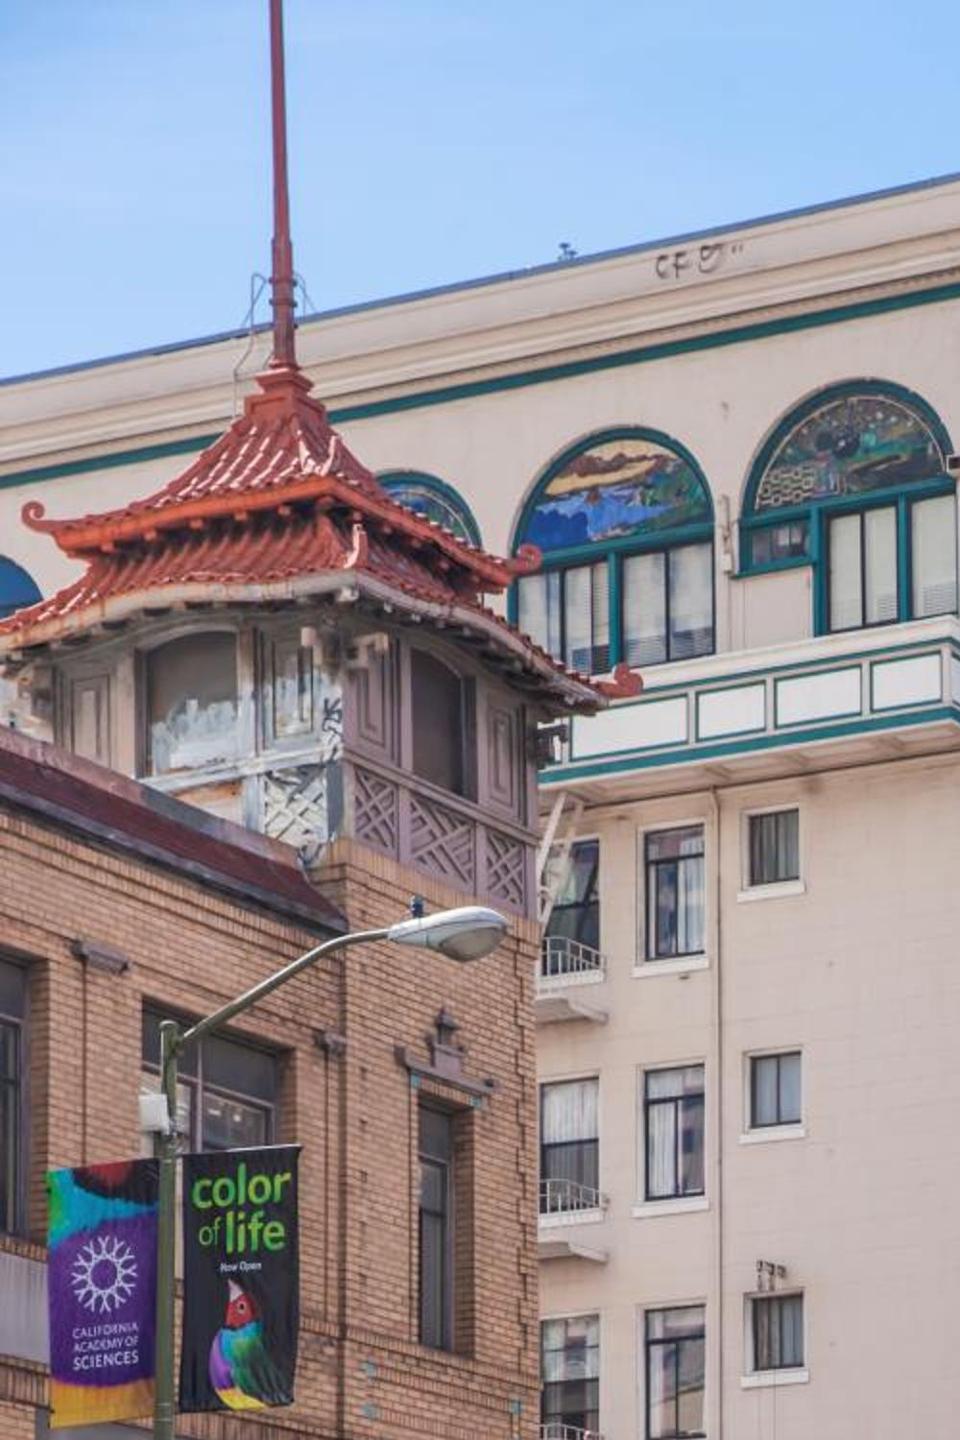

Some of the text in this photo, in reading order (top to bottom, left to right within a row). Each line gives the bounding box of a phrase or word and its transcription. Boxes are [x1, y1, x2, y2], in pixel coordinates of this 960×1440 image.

[192, 1162, 292, 1209] color
[199, 1210, 285, 1253] of life
[240, 1261, 262, 1271] Open
[72, 1322, 139, 1339] CALIFORNIA
[74, 1335, 139, 1353] ACADEMY OF
[72, 1350, 139, 1371] SCIENCES
